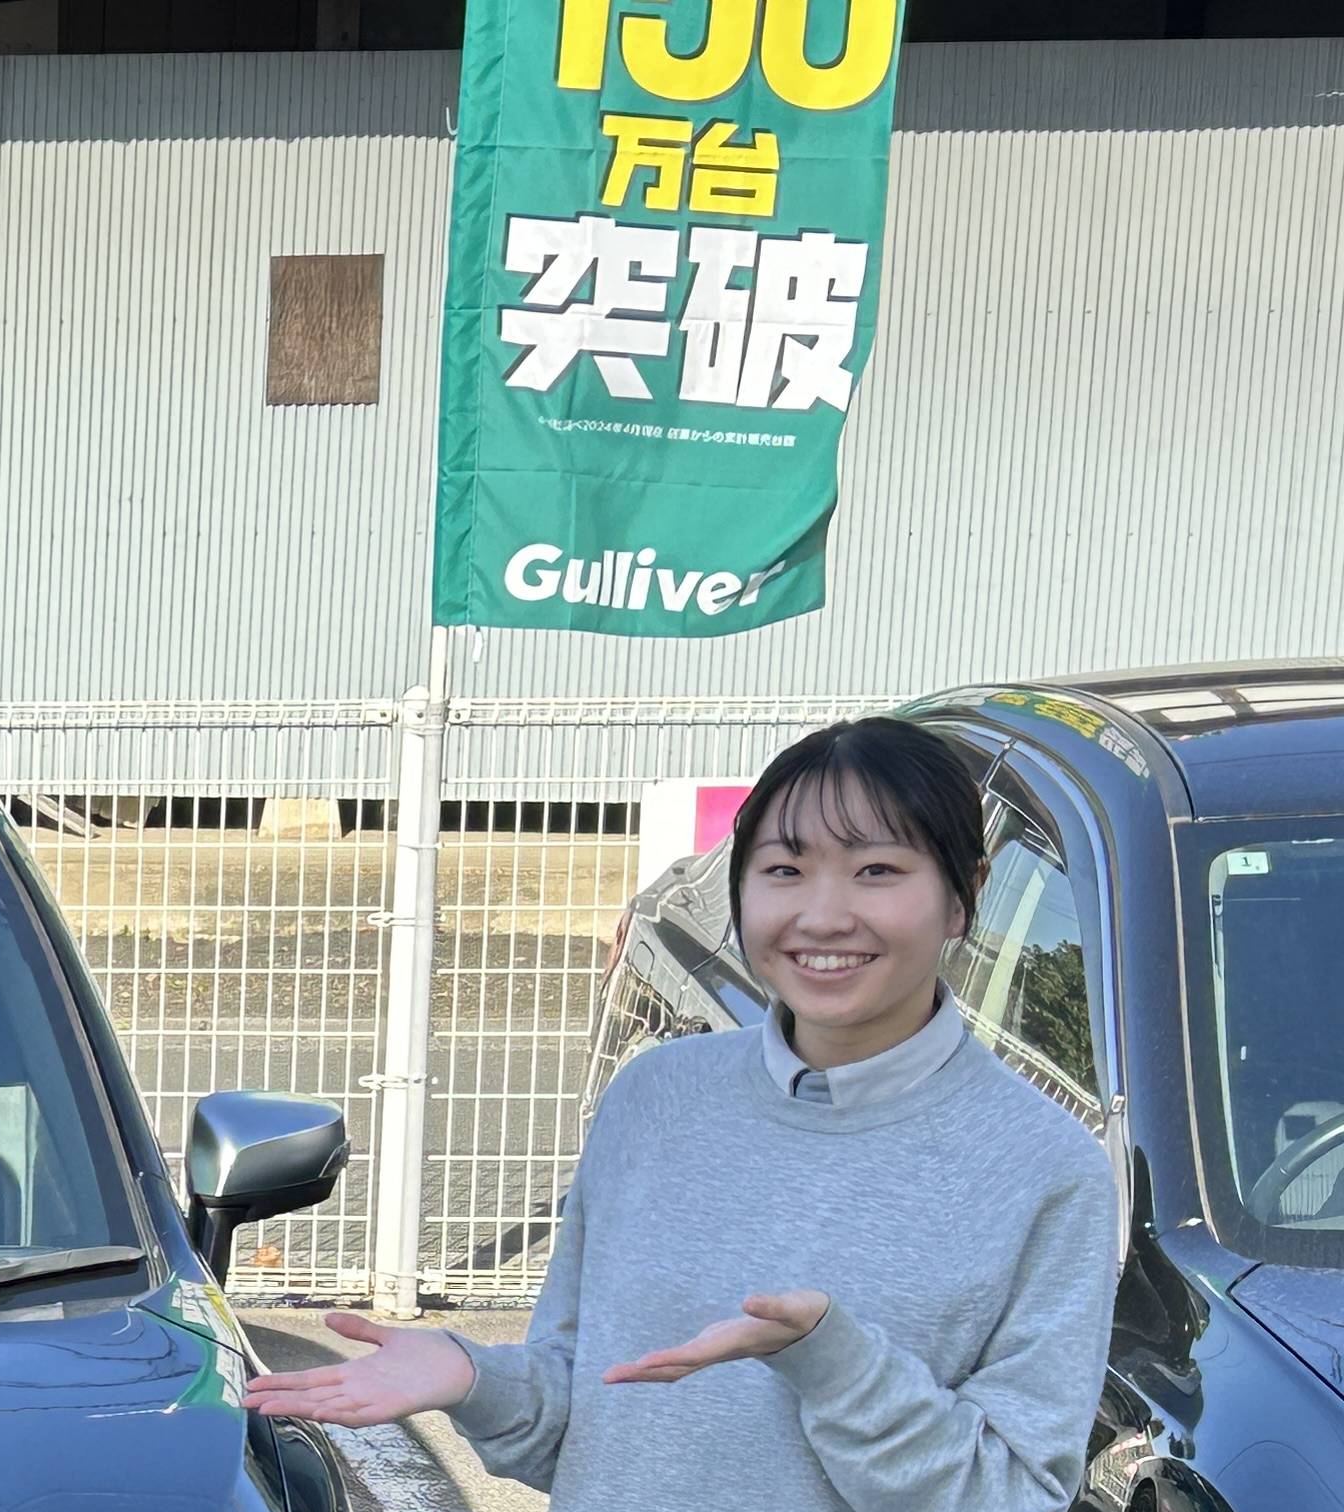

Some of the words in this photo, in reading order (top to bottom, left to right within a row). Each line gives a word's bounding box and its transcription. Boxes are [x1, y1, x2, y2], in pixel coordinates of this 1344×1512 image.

[601, 115, 780, 217] 万台
[500, 216, 869, 413] 突破
[504, 543, 786, 616] Gulliver
